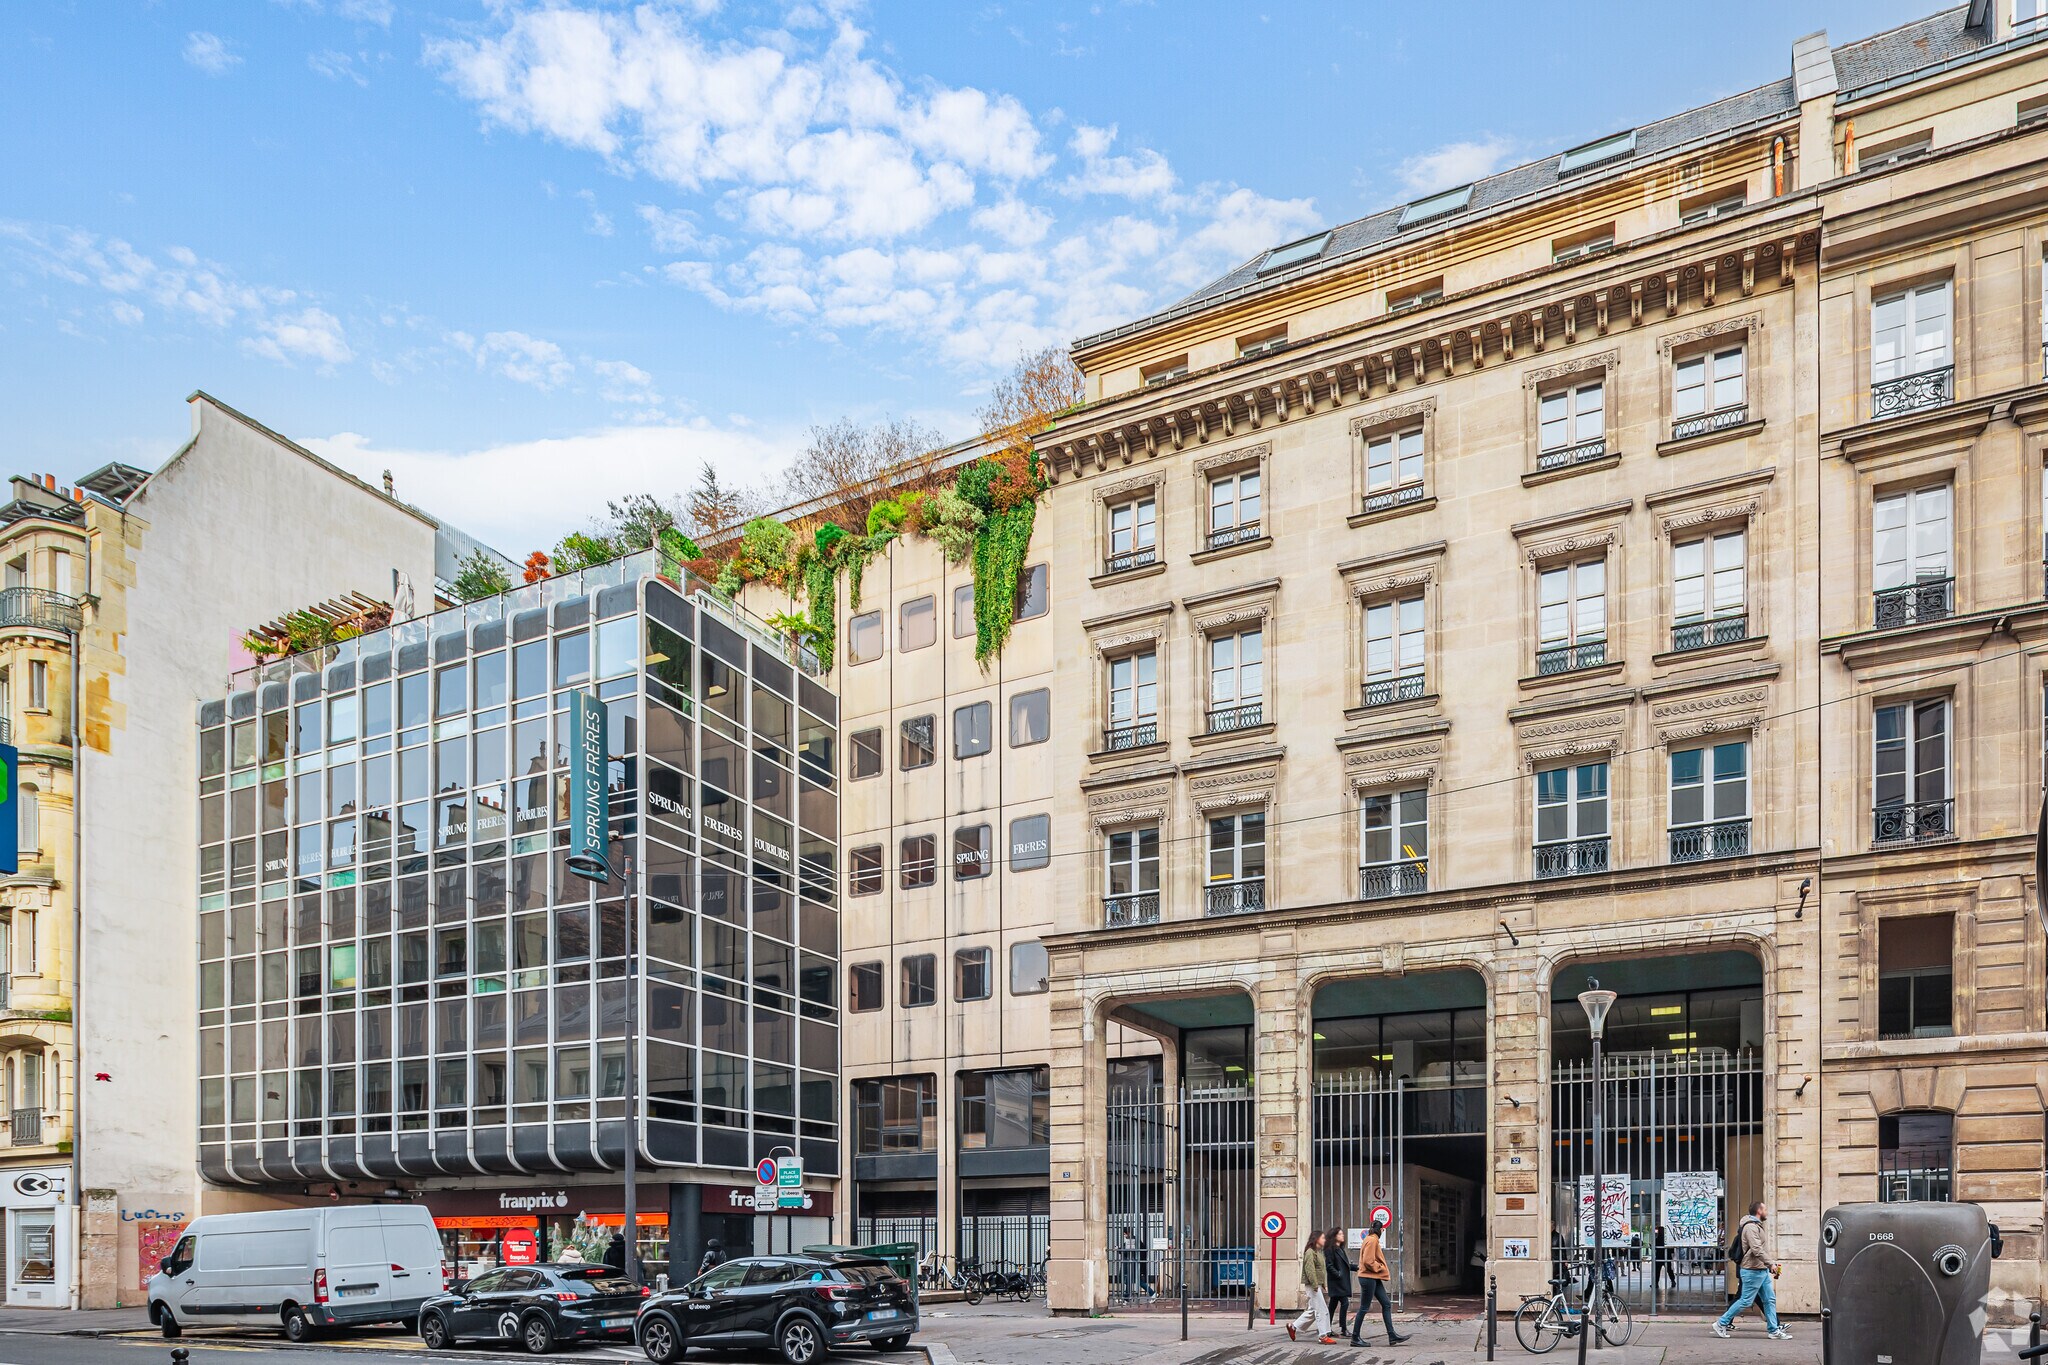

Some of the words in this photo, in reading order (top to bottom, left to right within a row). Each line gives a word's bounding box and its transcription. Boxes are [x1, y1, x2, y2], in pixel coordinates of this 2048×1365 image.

[582, 710, 600, 777] FRÈRES
[438, 821, 467, 838] SPRUNG
[477, 814, 506, 830] FRERES
[586, 779, 601, 850] SPRUNG
[648, 791, 692, 820] SPRUNG
[703, 815, 743, 841] FRERES
[754, 837, 790, 862] FOURRURES
[956, 849, 989, 865] SPRUNG
[1013, 839, 1047, 855] FRERES
[499, 1191, 555, 1212] franprix
